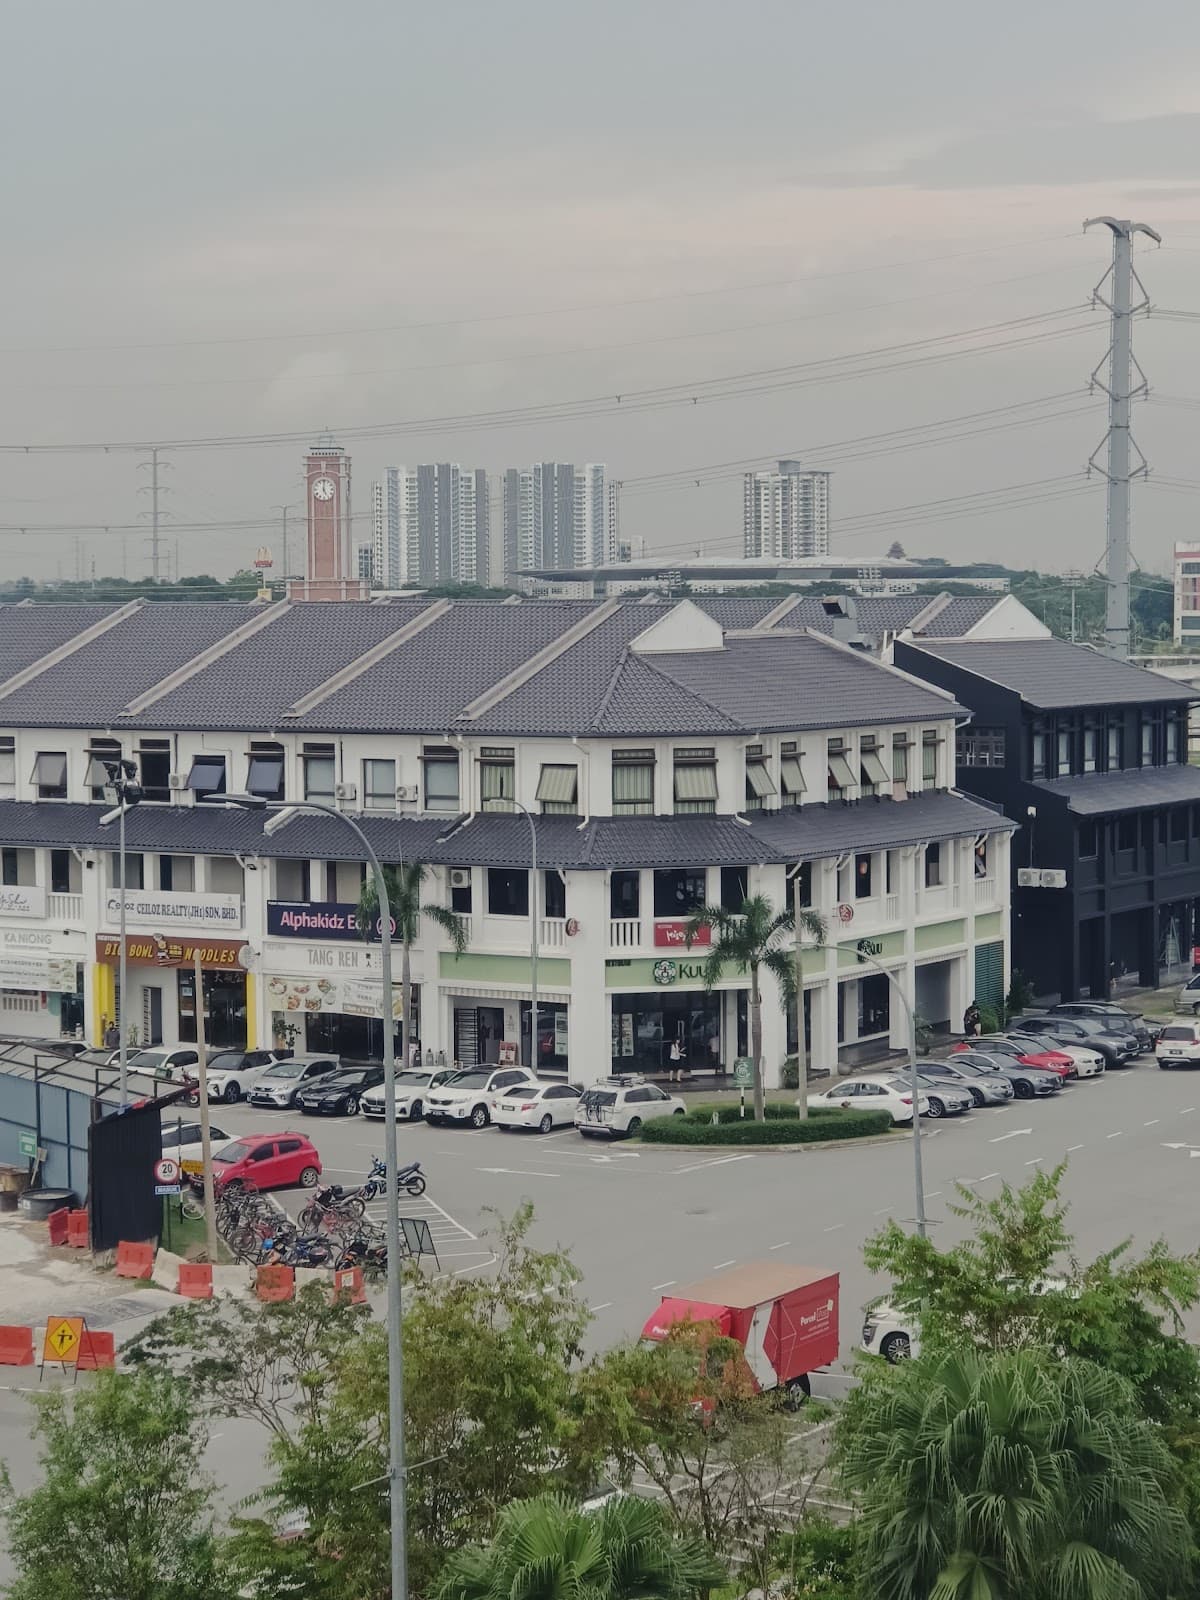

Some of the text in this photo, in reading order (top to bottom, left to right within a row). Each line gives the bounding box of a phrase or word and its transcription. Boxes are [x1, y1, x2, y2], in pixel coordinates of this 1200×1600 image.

[136, 903, 161, 915] CEILOZ
[161, 904, 188, 917] REALTY
[280, 911, 344, 932] Alphakidz
[128, 944, 153, 958] BOWL
[184, 947, 236, 963] NODLES
[307, 949, 334, 966] TANG
[162, 1163, 173, 1174] 20
